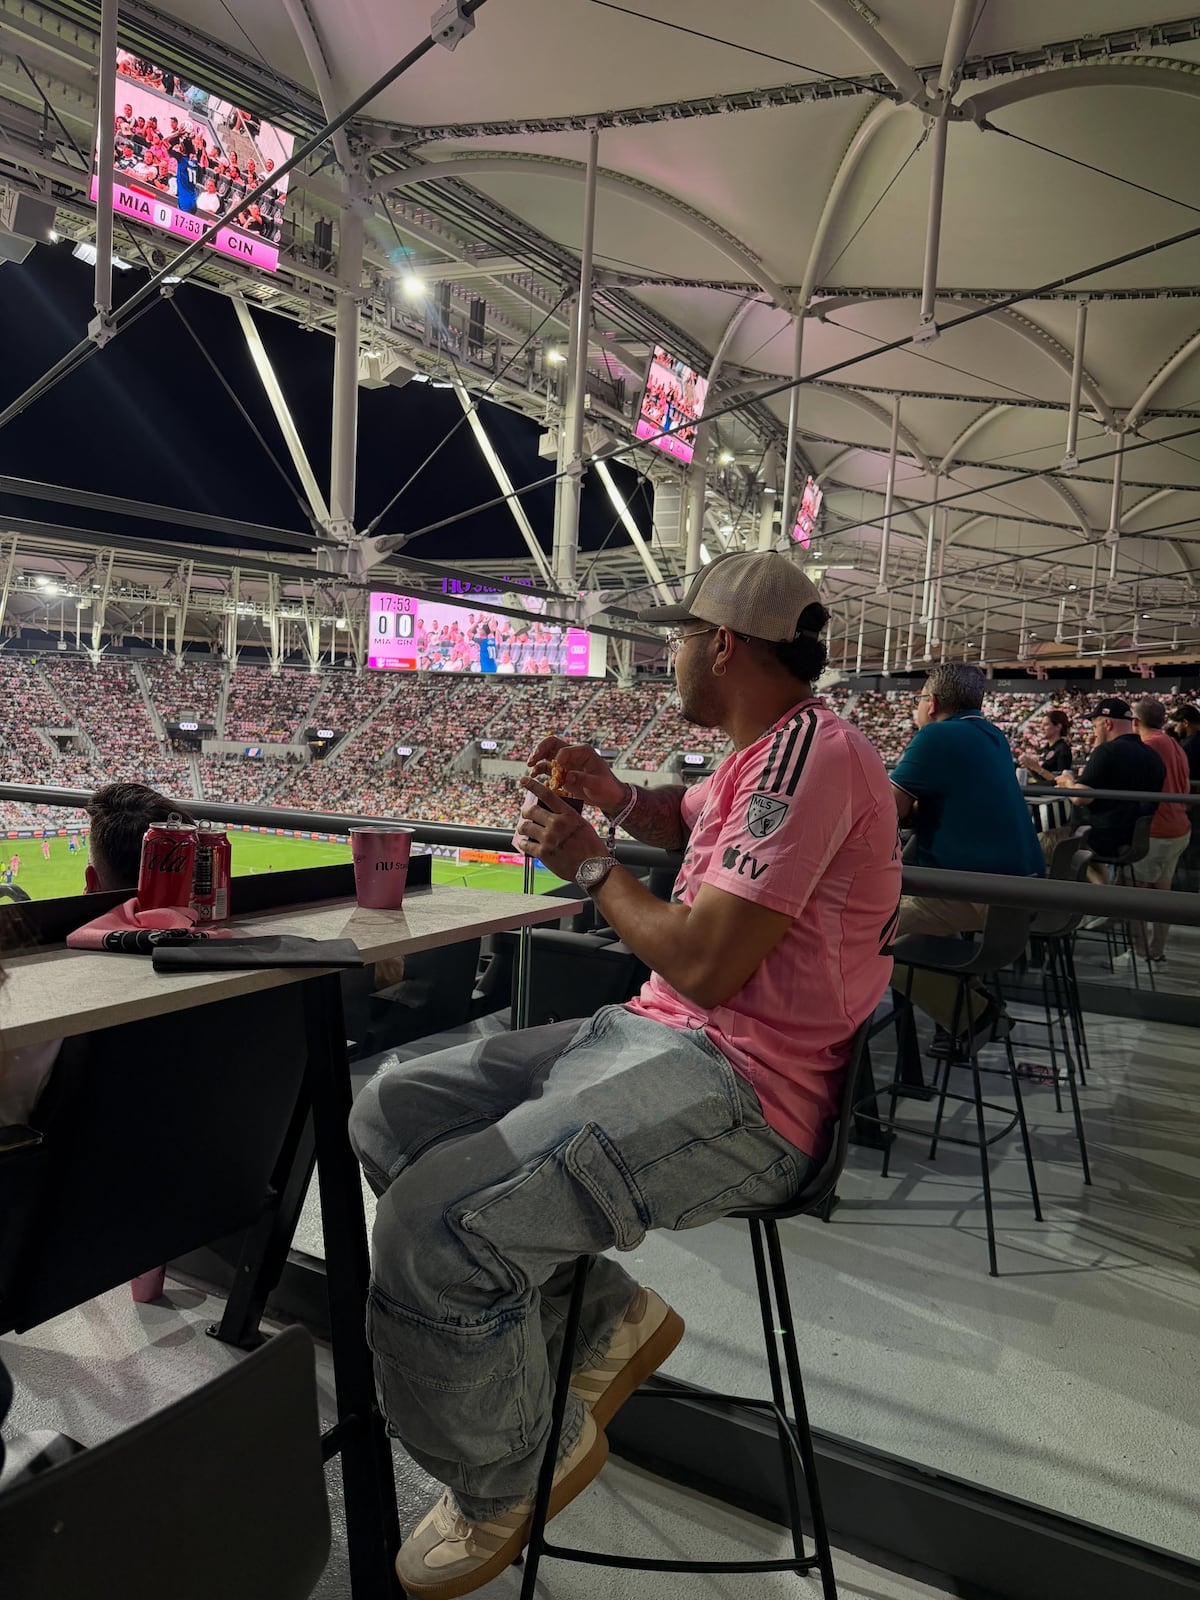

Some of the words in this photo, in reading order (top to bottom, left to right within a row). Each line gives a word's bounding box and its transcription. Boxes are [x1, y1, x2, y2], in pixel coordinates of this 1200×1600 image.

[119, 191, 151, 216] MIA
[159, 208, 166, 222] 0
[174, 213, 200, 235] 17:53
[227, 236, 254, 256] CIN
[380, 597, 411, 612] 17:53
[378, 615, 387, 635] 0
[399, 614, 412, 638] 0
[997, 679, 1012, 687] 204
[753, 797, 772, 810] MLS
[738, 852, 769, 880] tv
